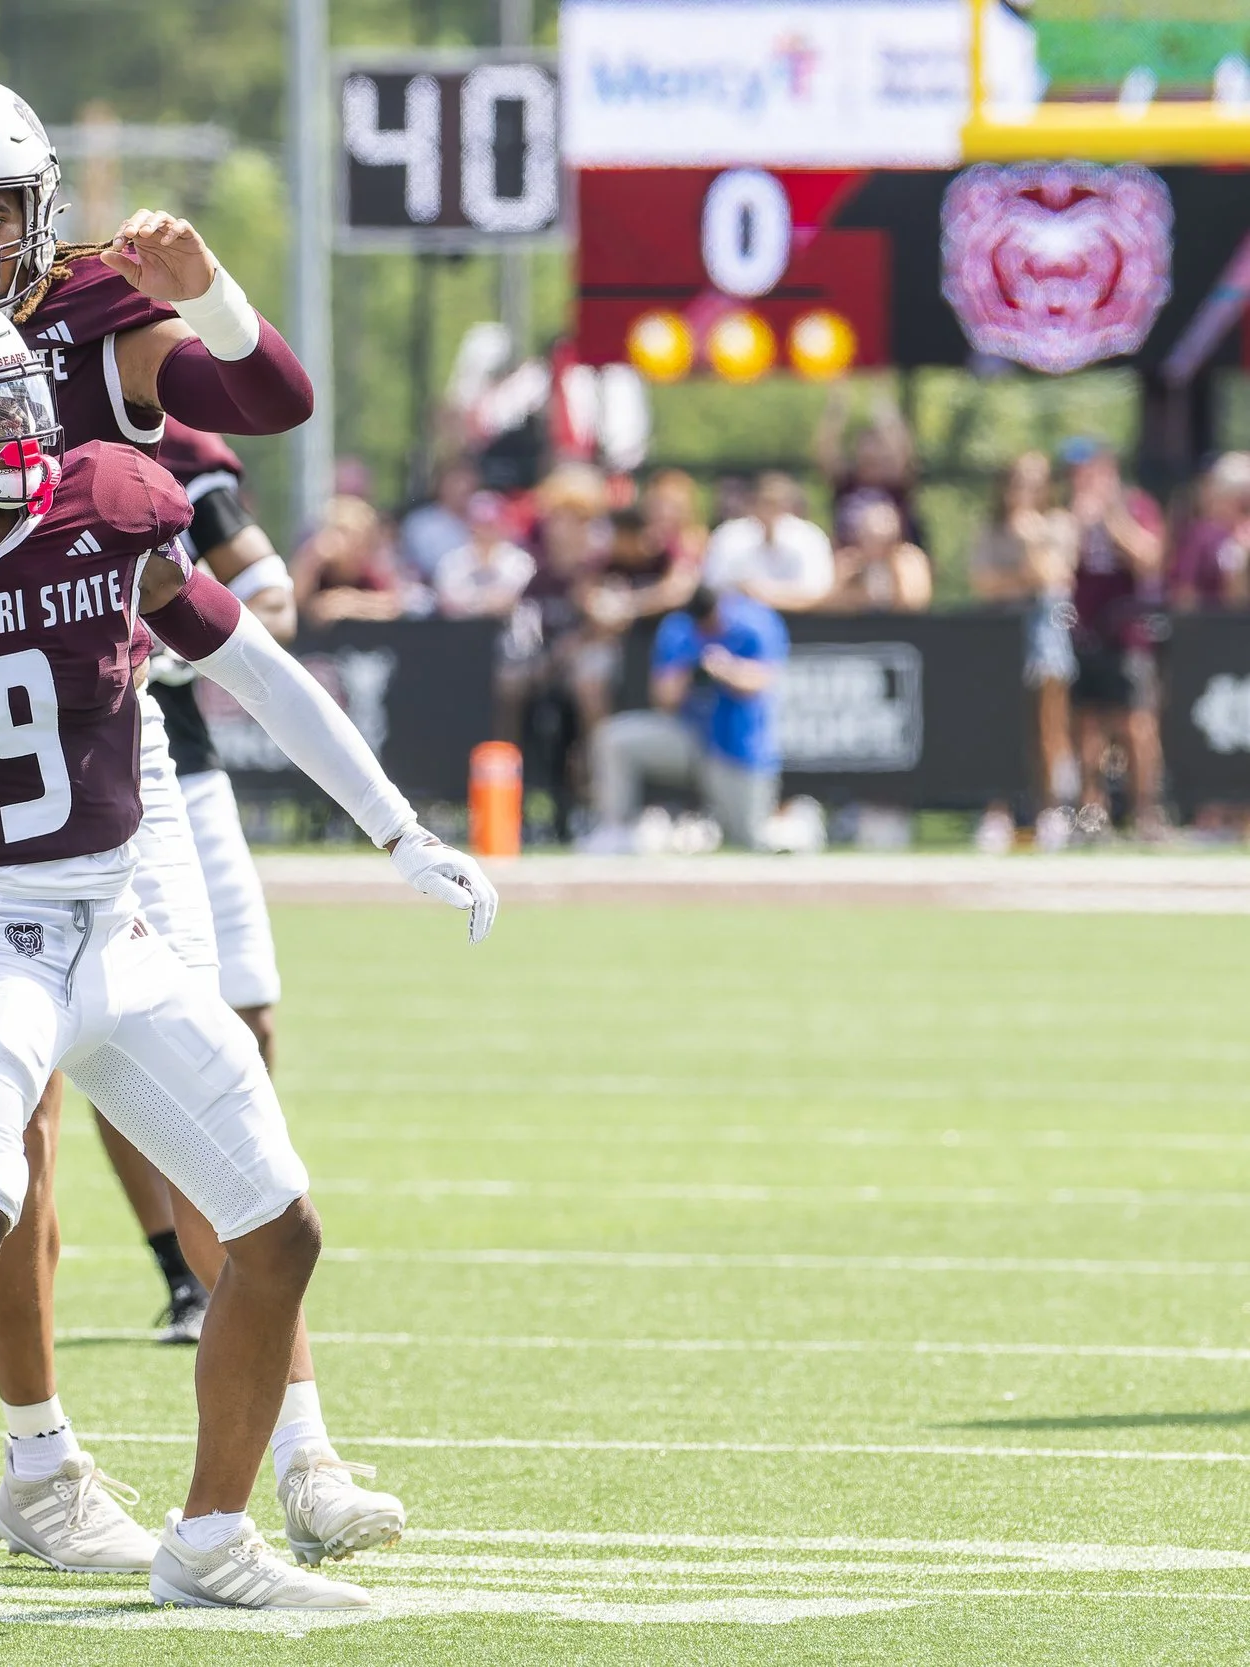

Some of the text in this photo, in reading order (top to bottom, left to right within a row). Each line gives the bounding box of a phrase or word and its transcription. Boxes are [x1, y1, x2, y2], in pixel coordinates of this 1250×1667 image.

[344, 63, 558, 232] 40
[702, 168, 791, 298] 0
[40, 569, 124, 628] STATE
